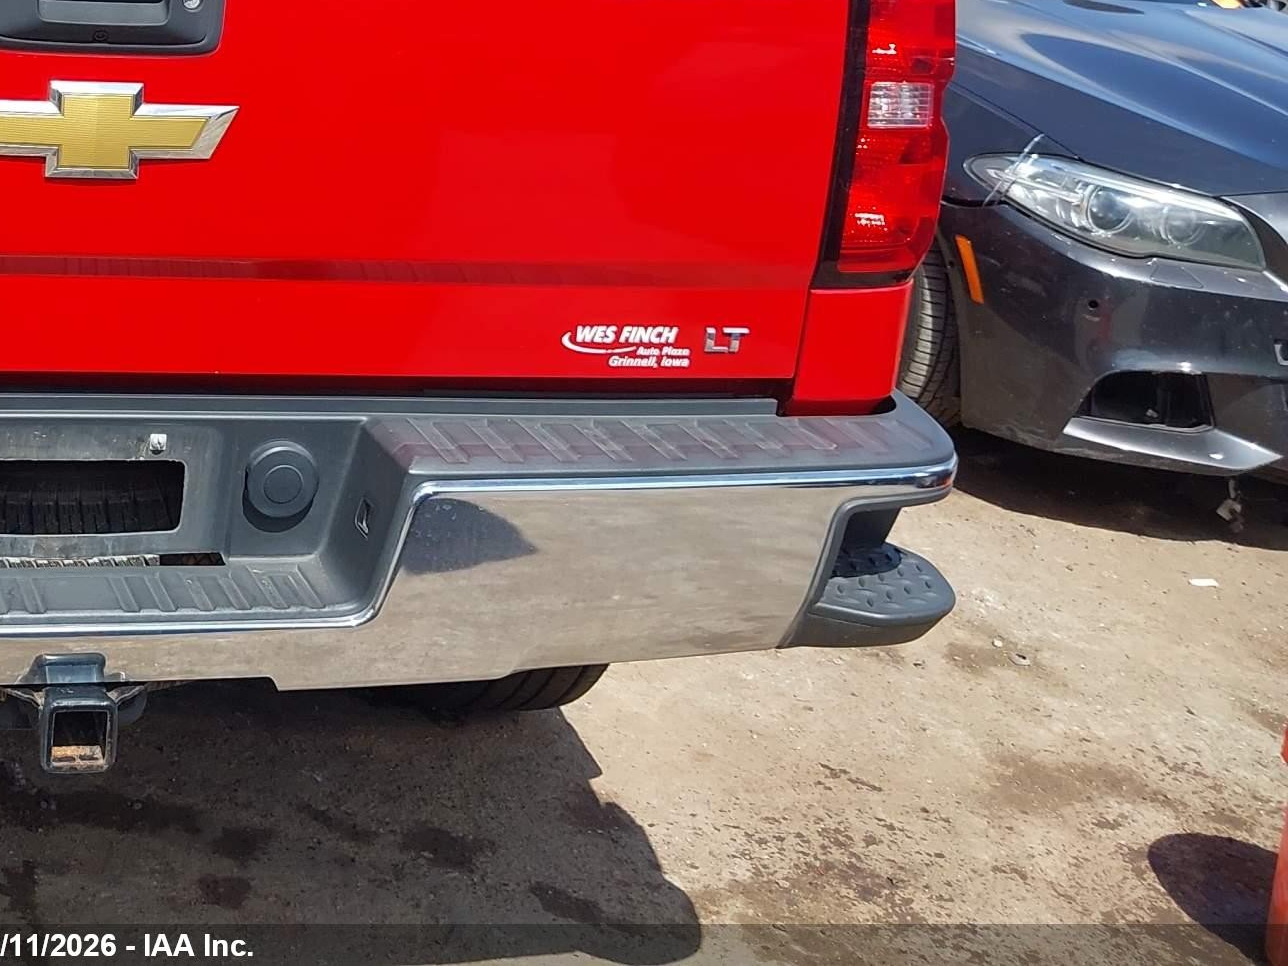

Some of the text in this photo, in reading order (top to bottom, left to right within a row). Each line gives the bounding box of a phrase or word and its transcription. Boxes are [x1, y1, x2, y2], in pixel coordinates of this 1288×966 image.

[575, 325, 679, 344] WES FINCH
[703, 327, 750, 353] LT
[636, 346, 690, 357] Auto Plaza
[608, 356, 690, 369] Grinnell, Iowa
